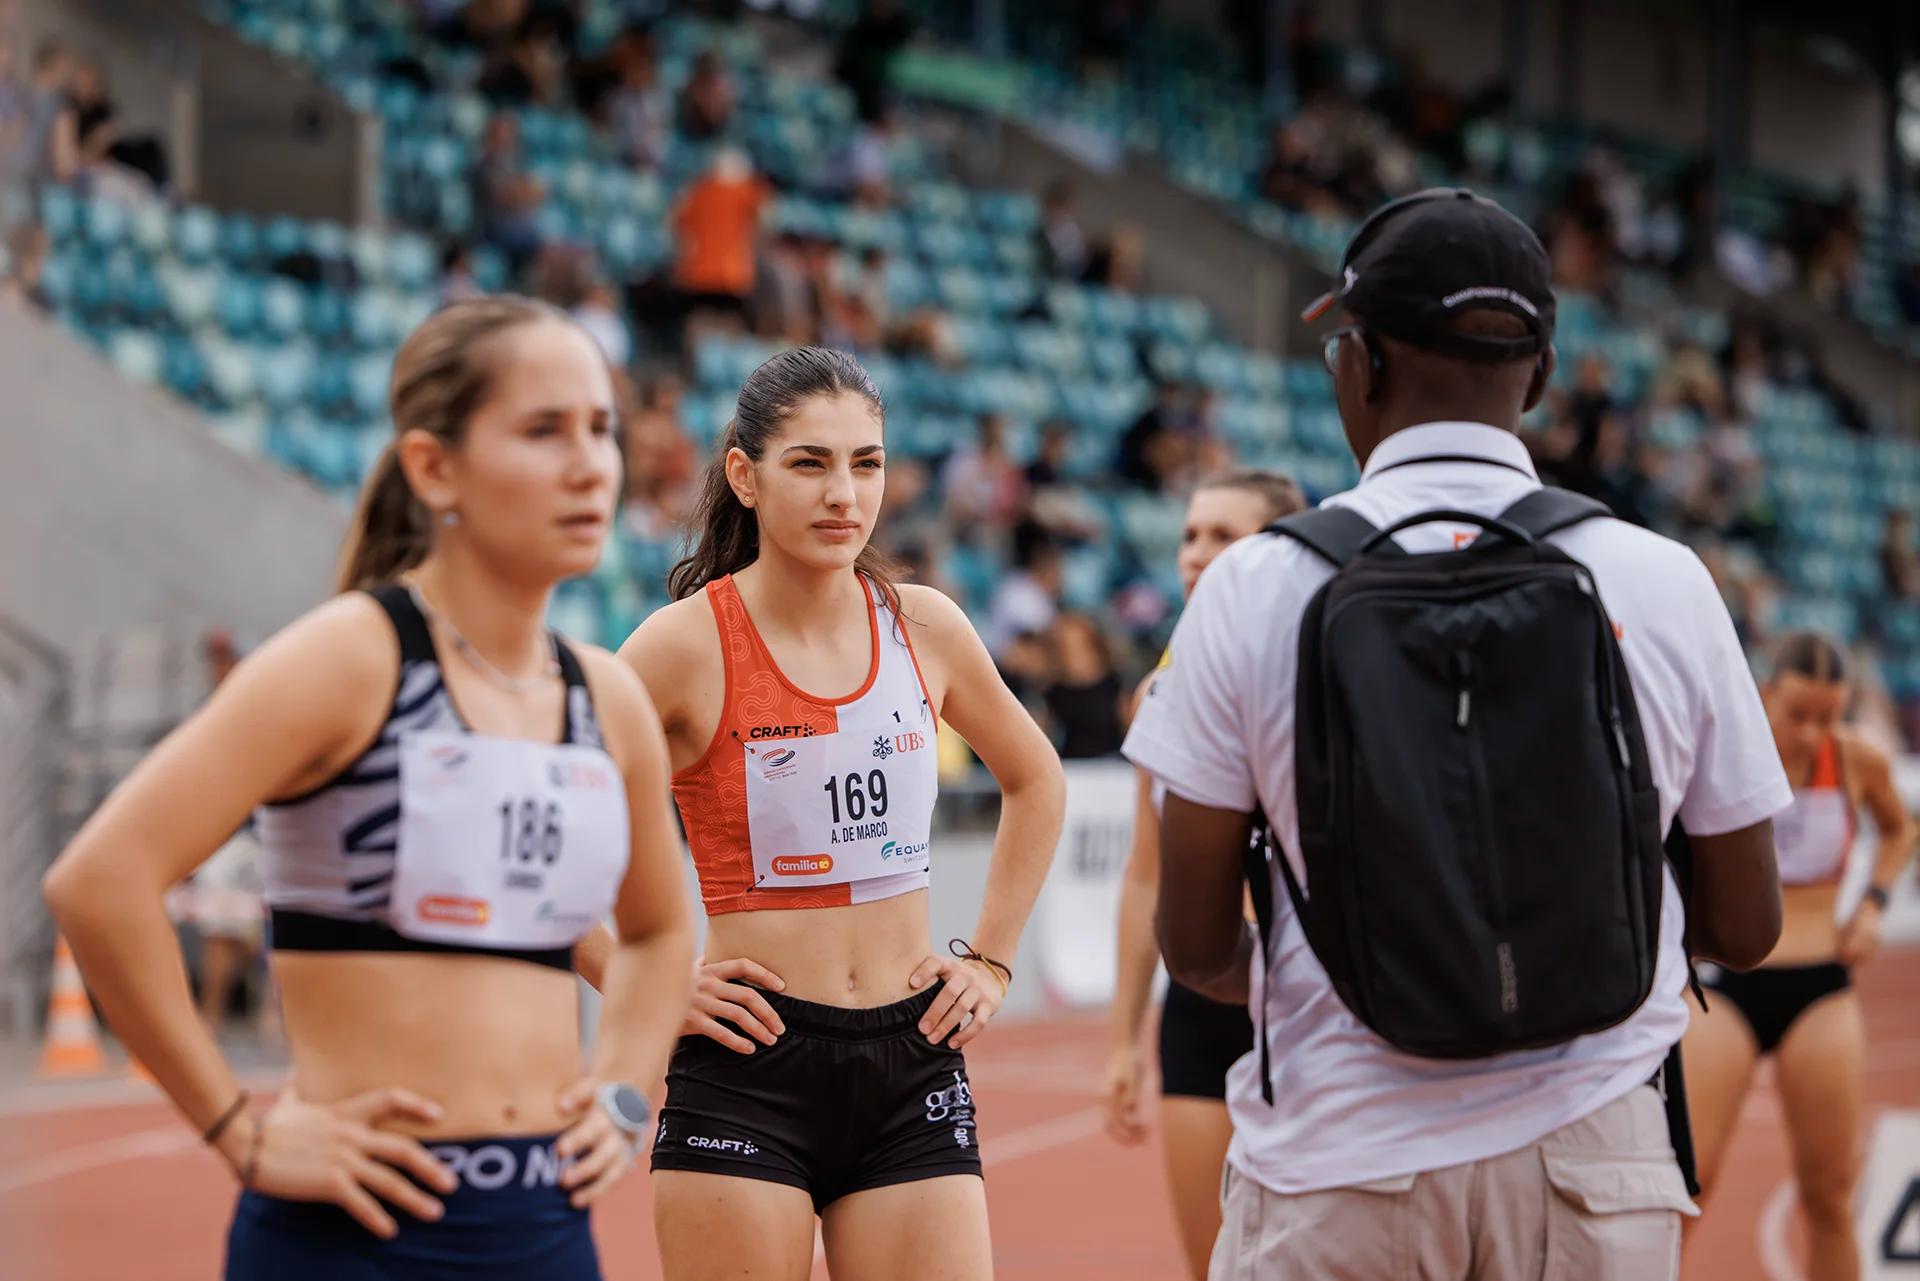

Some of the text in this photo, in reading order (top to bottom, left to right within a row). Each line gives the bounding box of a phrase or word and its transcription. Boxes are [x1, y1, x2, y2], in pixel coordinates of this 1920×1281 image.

[750, 725, 801, 738] CRAFT
[895, 731, 925, 753] UBS
[824, 769, 888, 823] 169
[498, 797, 563, 866] 186
[831, 821, 888, 844] A. DE MARCO
[776, 860, 819, 872] familia
[687, 1136, 743, 1151] CRAFT
